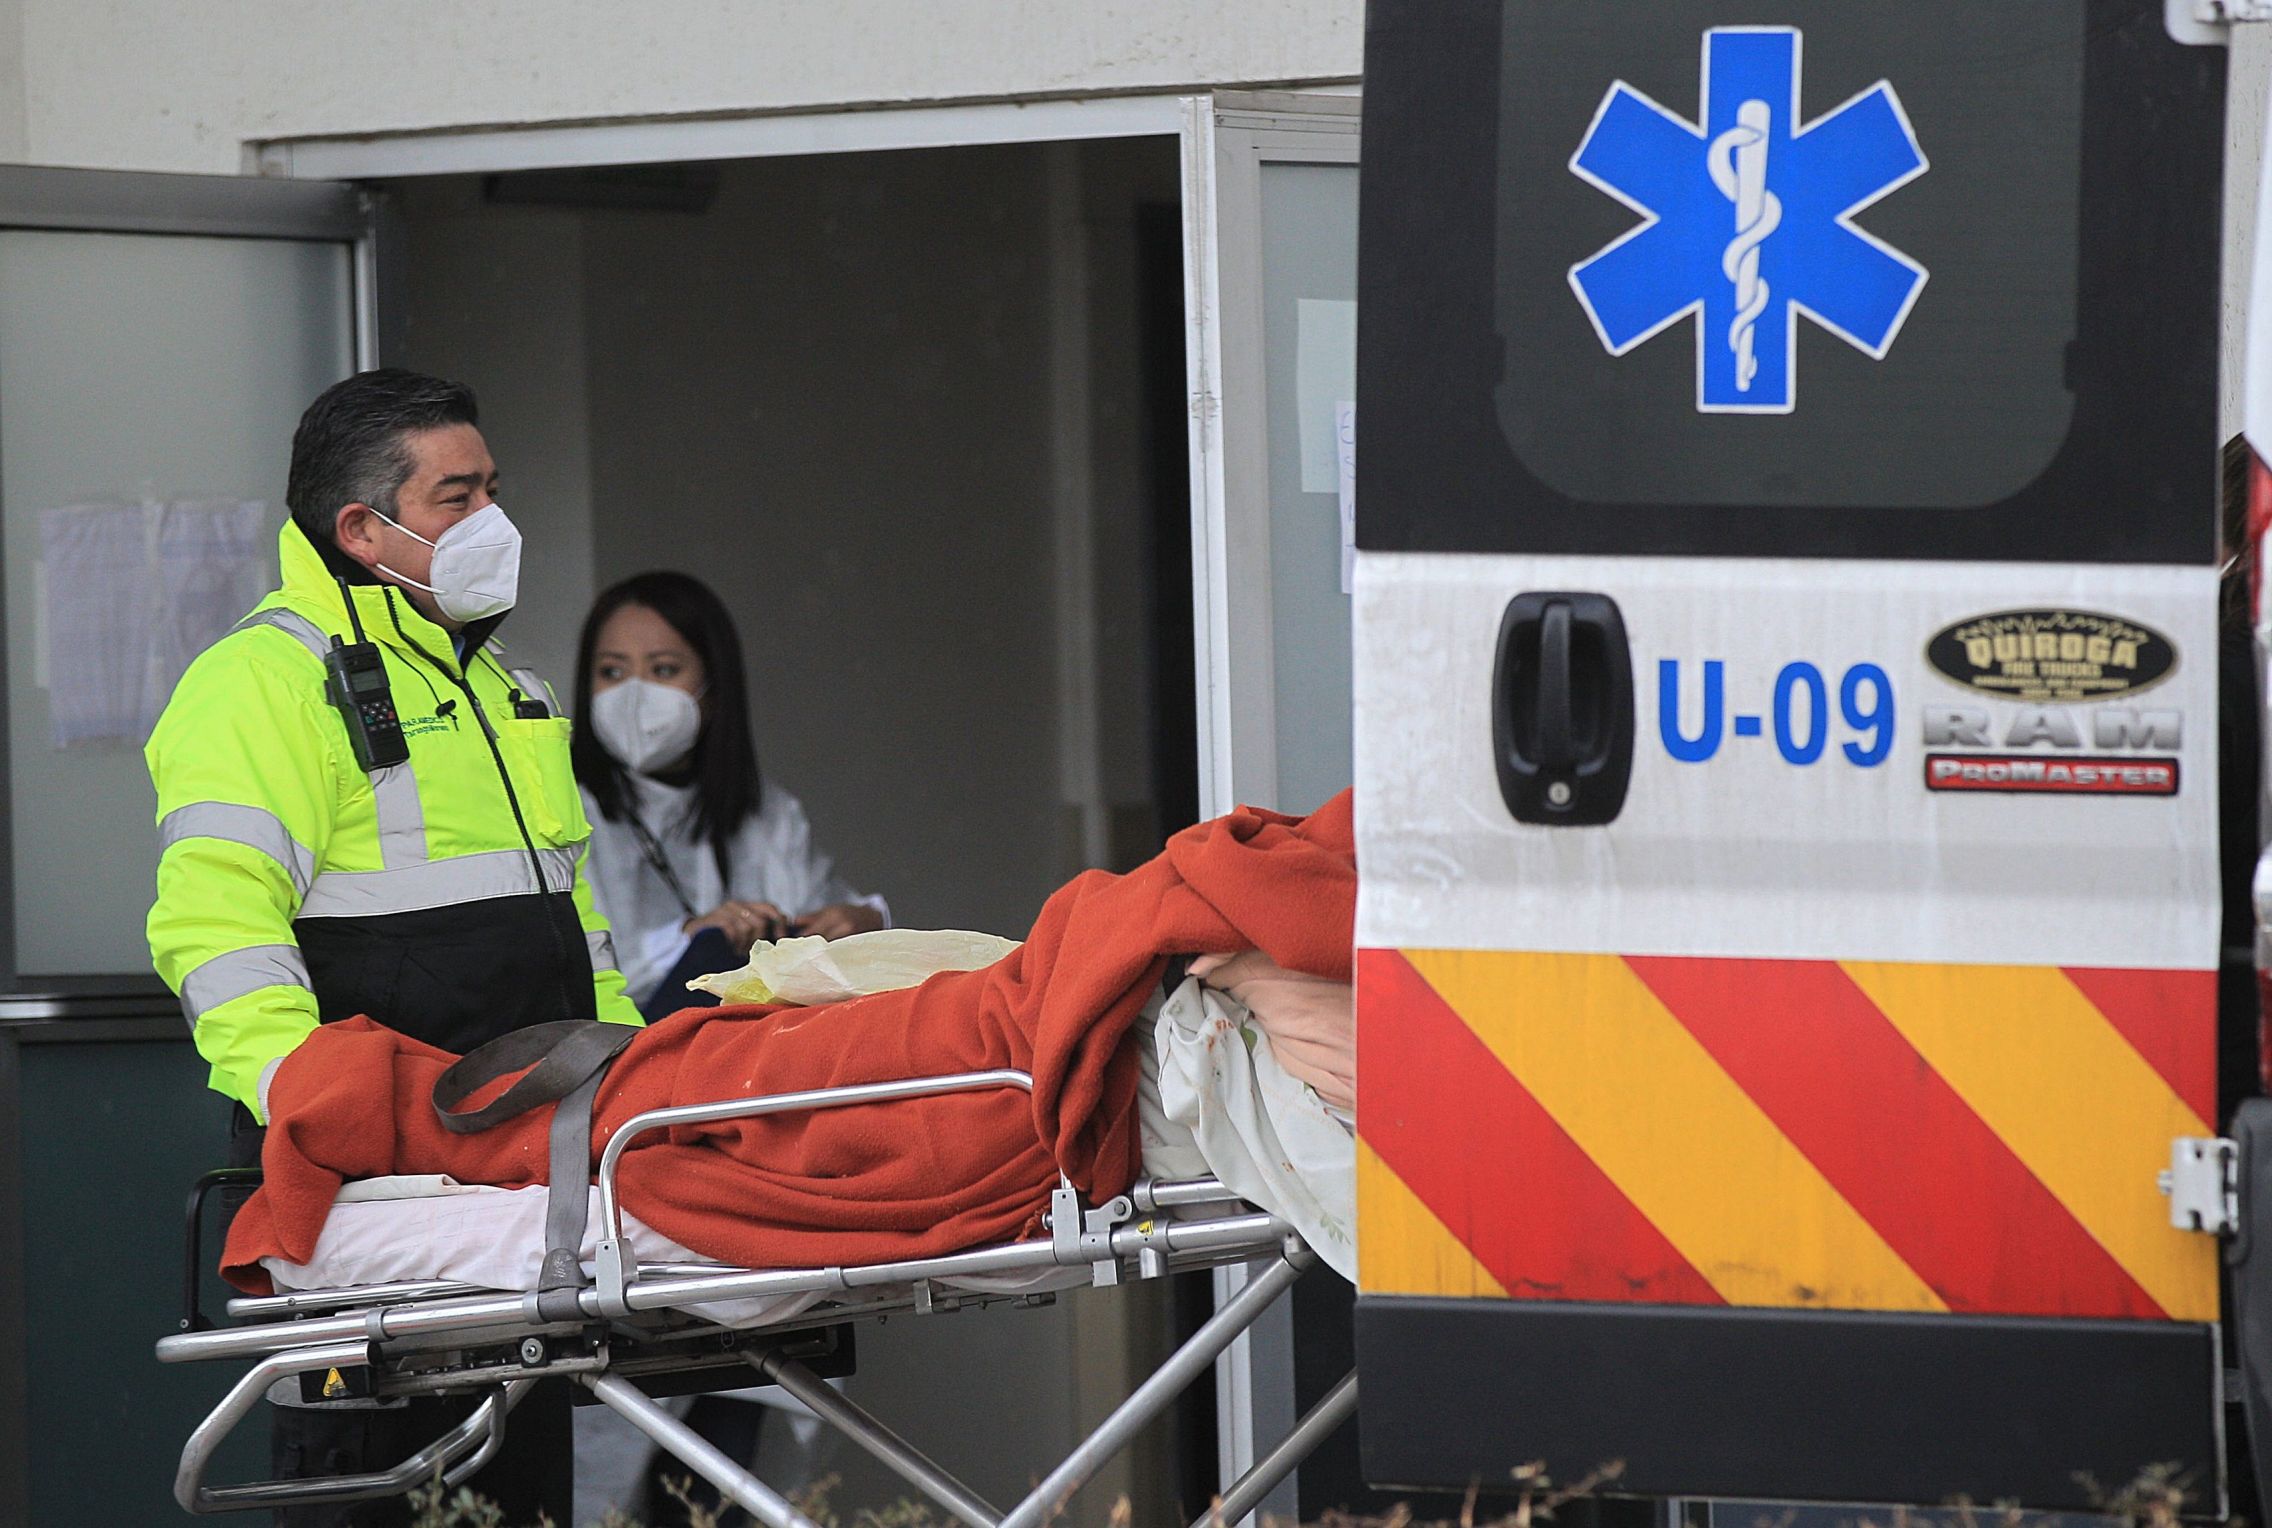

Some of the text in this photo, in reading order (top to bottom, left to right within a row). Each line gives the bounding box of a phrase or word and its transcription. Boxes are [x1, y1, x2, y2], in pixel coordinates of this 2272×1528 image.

[1965, 632, 2137, 669] QUIROGA
[1659, 660, 1895, 768] U-09
[1923, 706, 2182, 750] RAM
